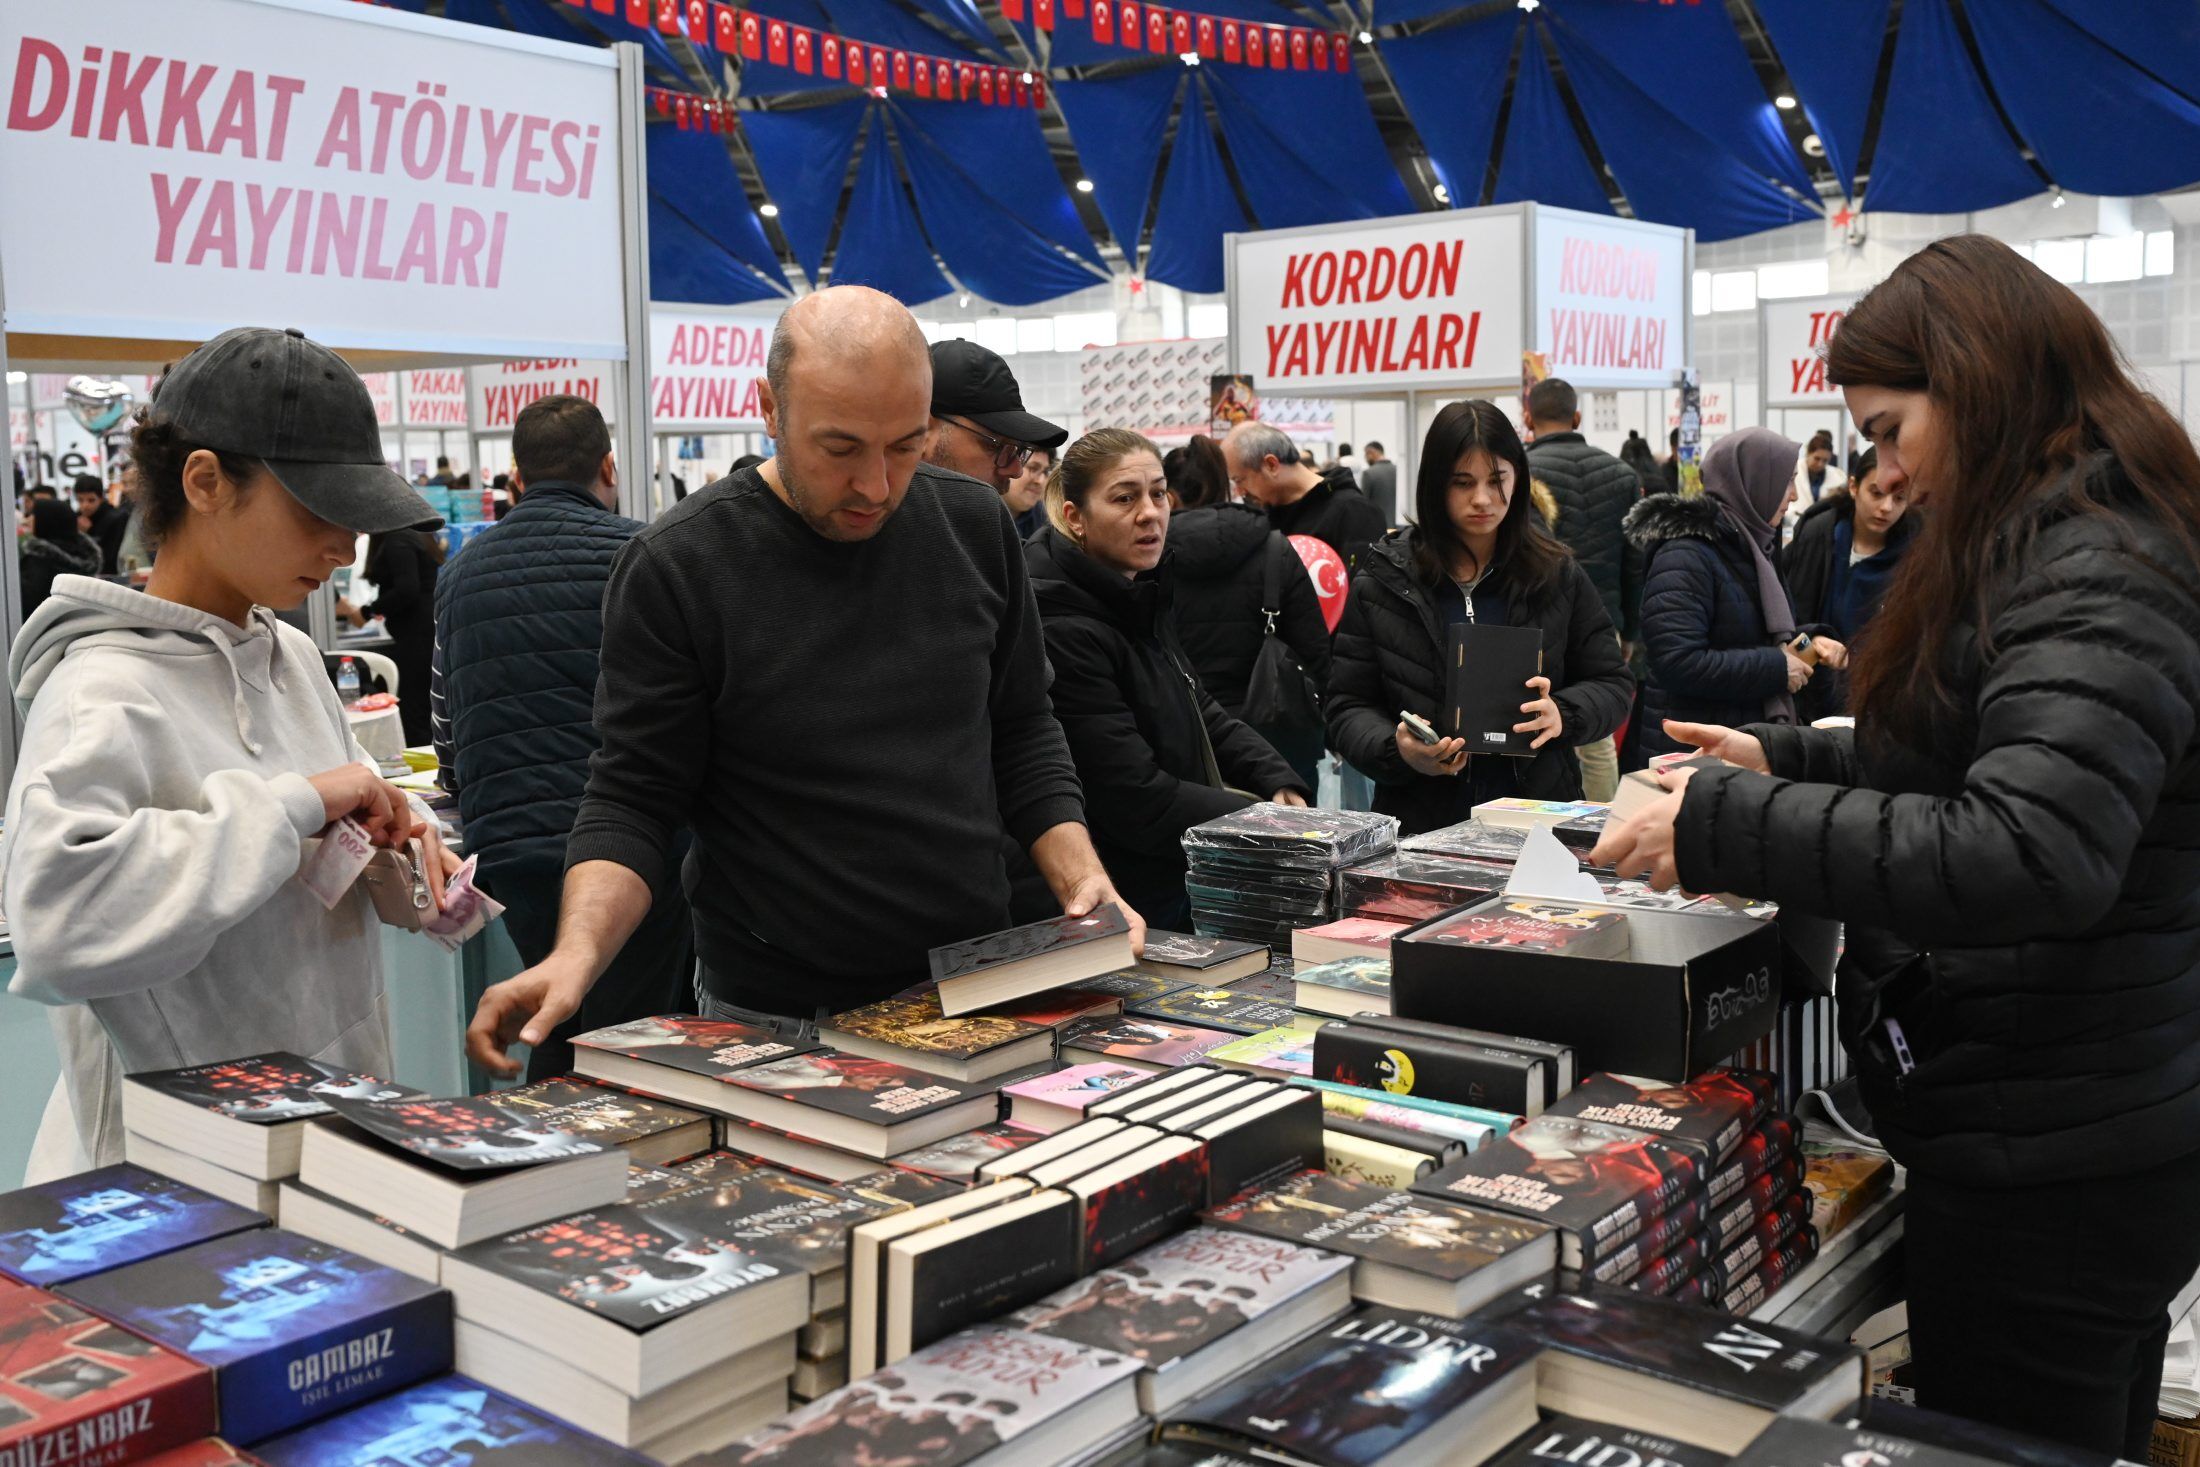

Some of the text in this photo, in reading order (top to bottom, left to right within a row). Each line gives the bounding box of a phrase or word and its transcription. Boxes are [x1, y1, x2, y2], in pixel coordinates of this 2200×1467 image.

[7, 37, 600, 199] DİKKAT ATÖLYESİ
[150, 172, 508, 288] YAYINLARI
[1280, 239, 1464, 308] KORDON
[1559, 237, 1658, 301] KORDON
[667, 324, 765, 367] ADEDA
[1266, 311, 1481, 377] YAYINLARI
[1550, 308, 1667, 370] YAYINLARI
[337, 831, 368, 859] 200
